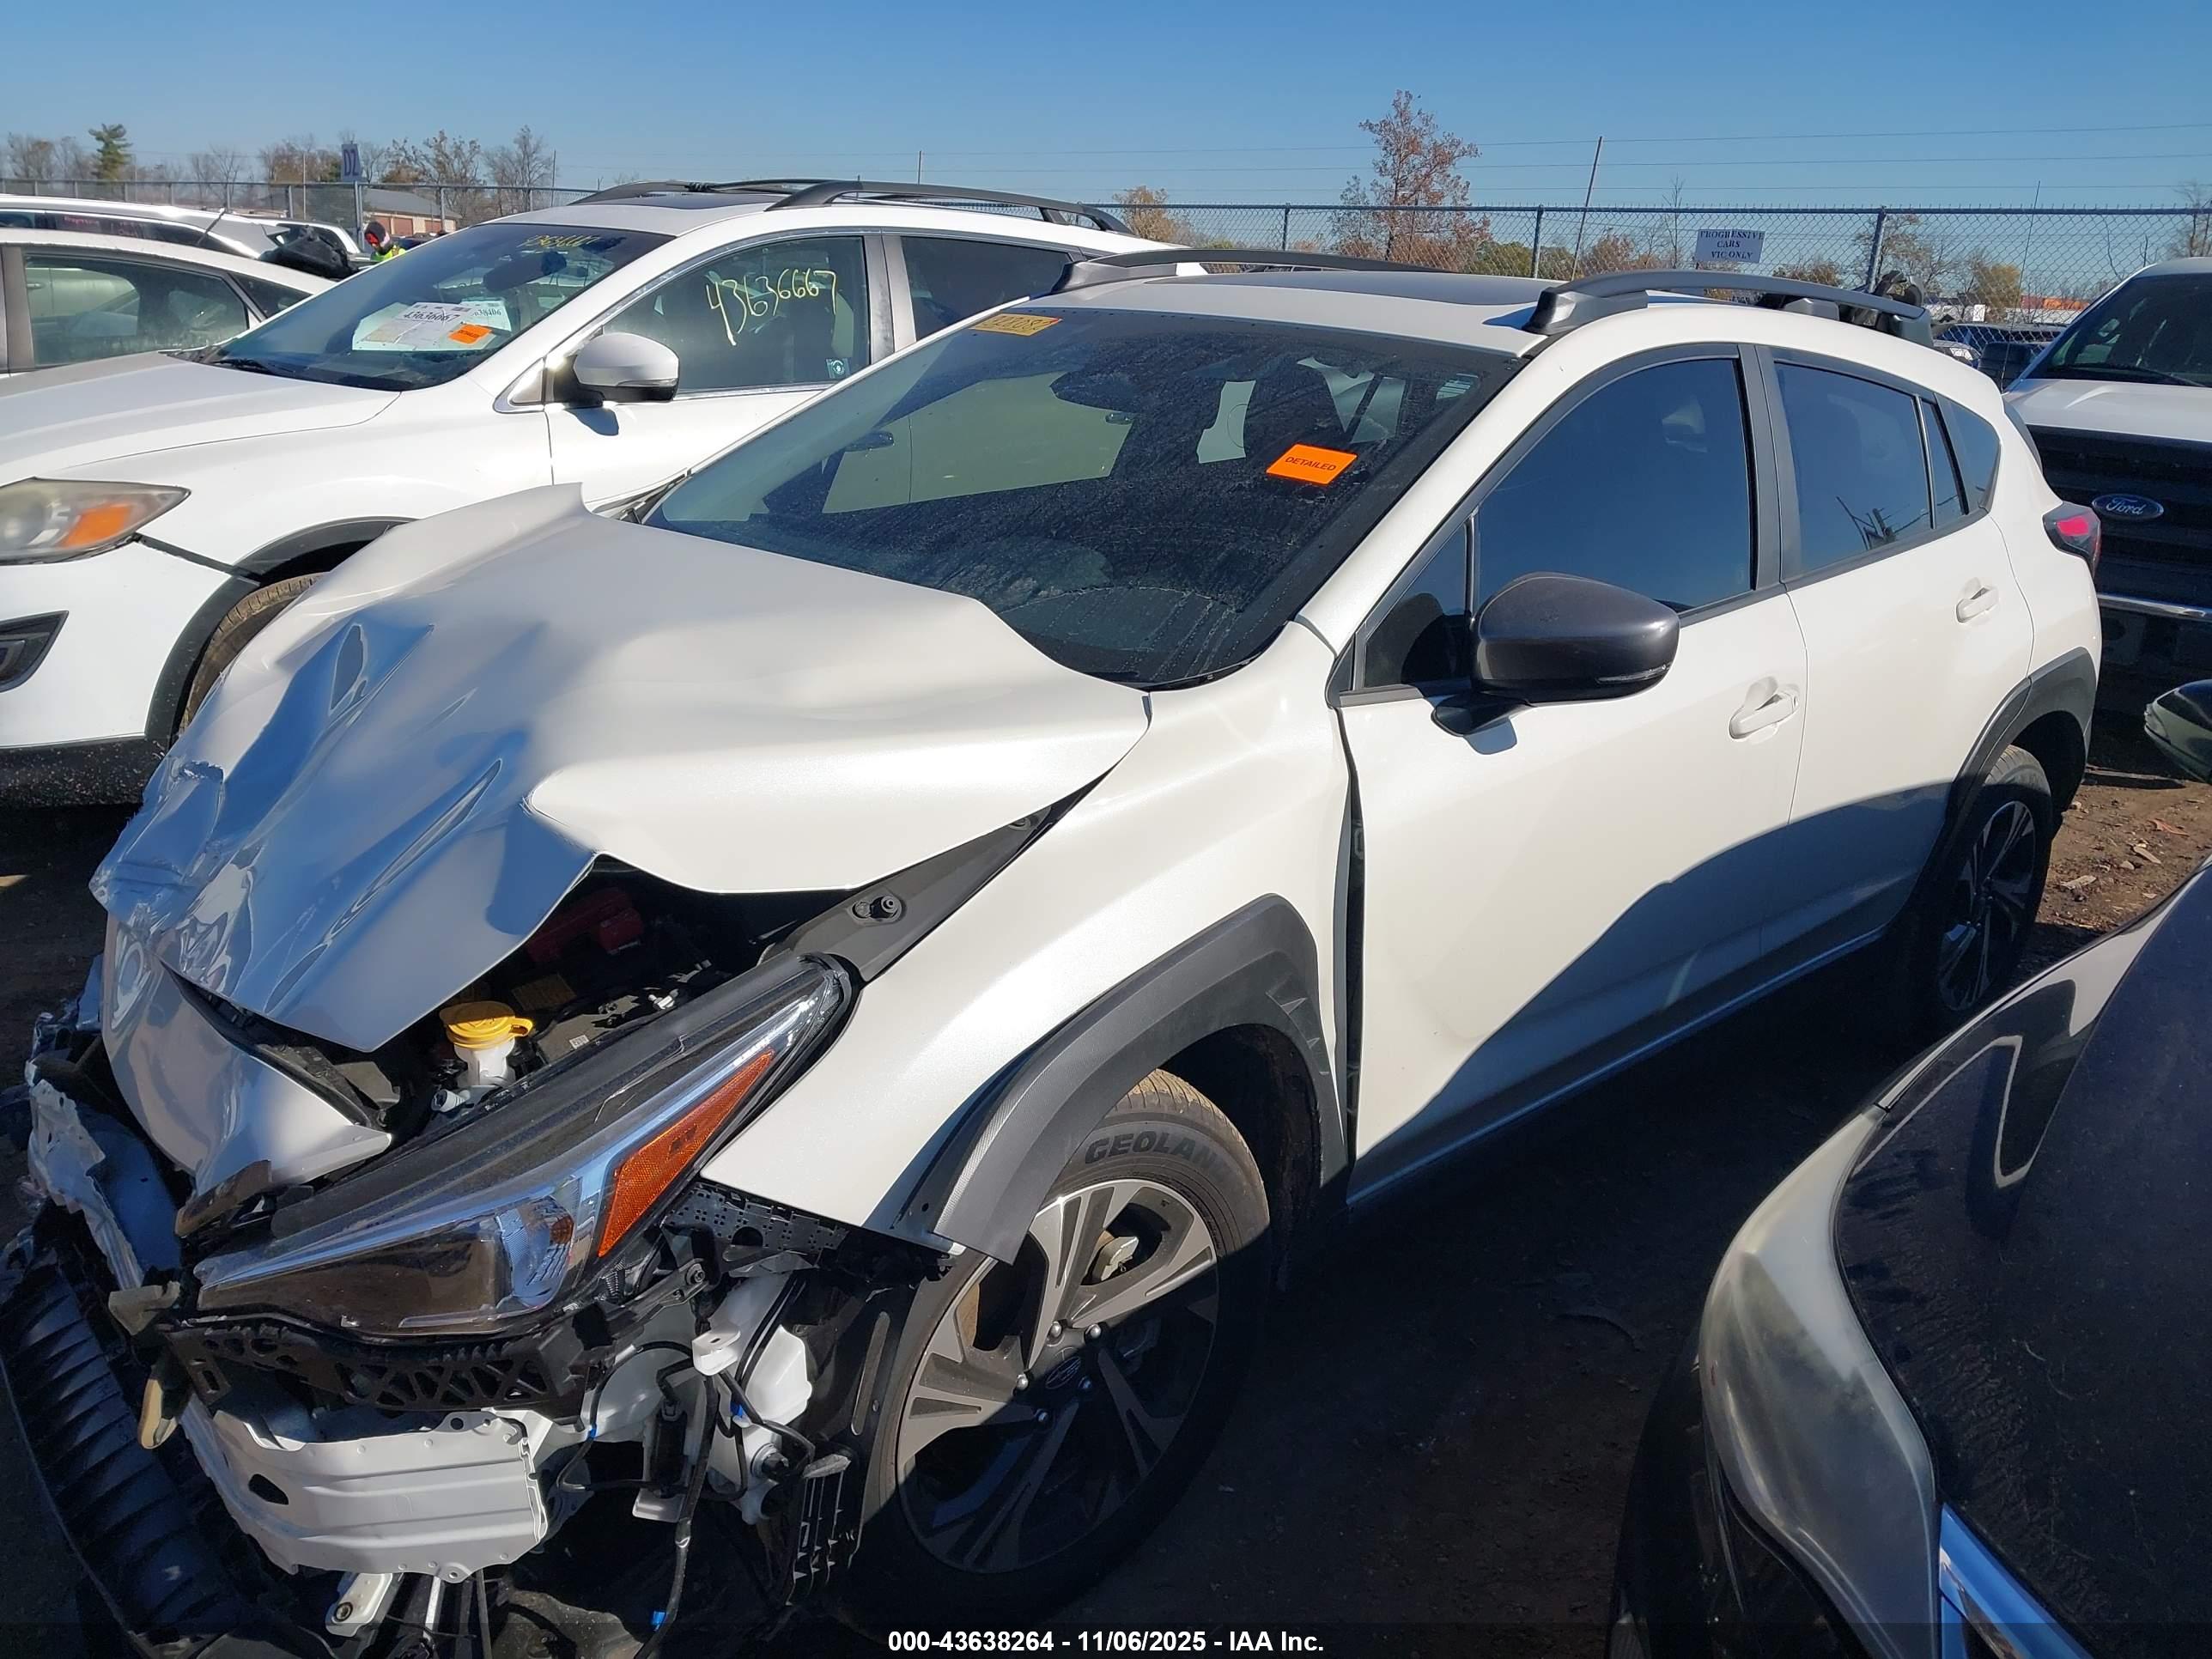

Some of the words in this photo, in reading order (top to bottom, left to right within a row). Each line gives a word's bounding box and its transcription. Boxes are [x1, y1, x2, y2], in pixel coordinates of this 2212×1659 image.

[1700, 230, 1765, 240] PROGRESSIVE
[1728, 251, 1753, 259] ONLY
[706, 268, 837, 346] 43636667
[1285, 456, 1337, 471] DETAILED
[2106, 497, 2147, 515] Ford
